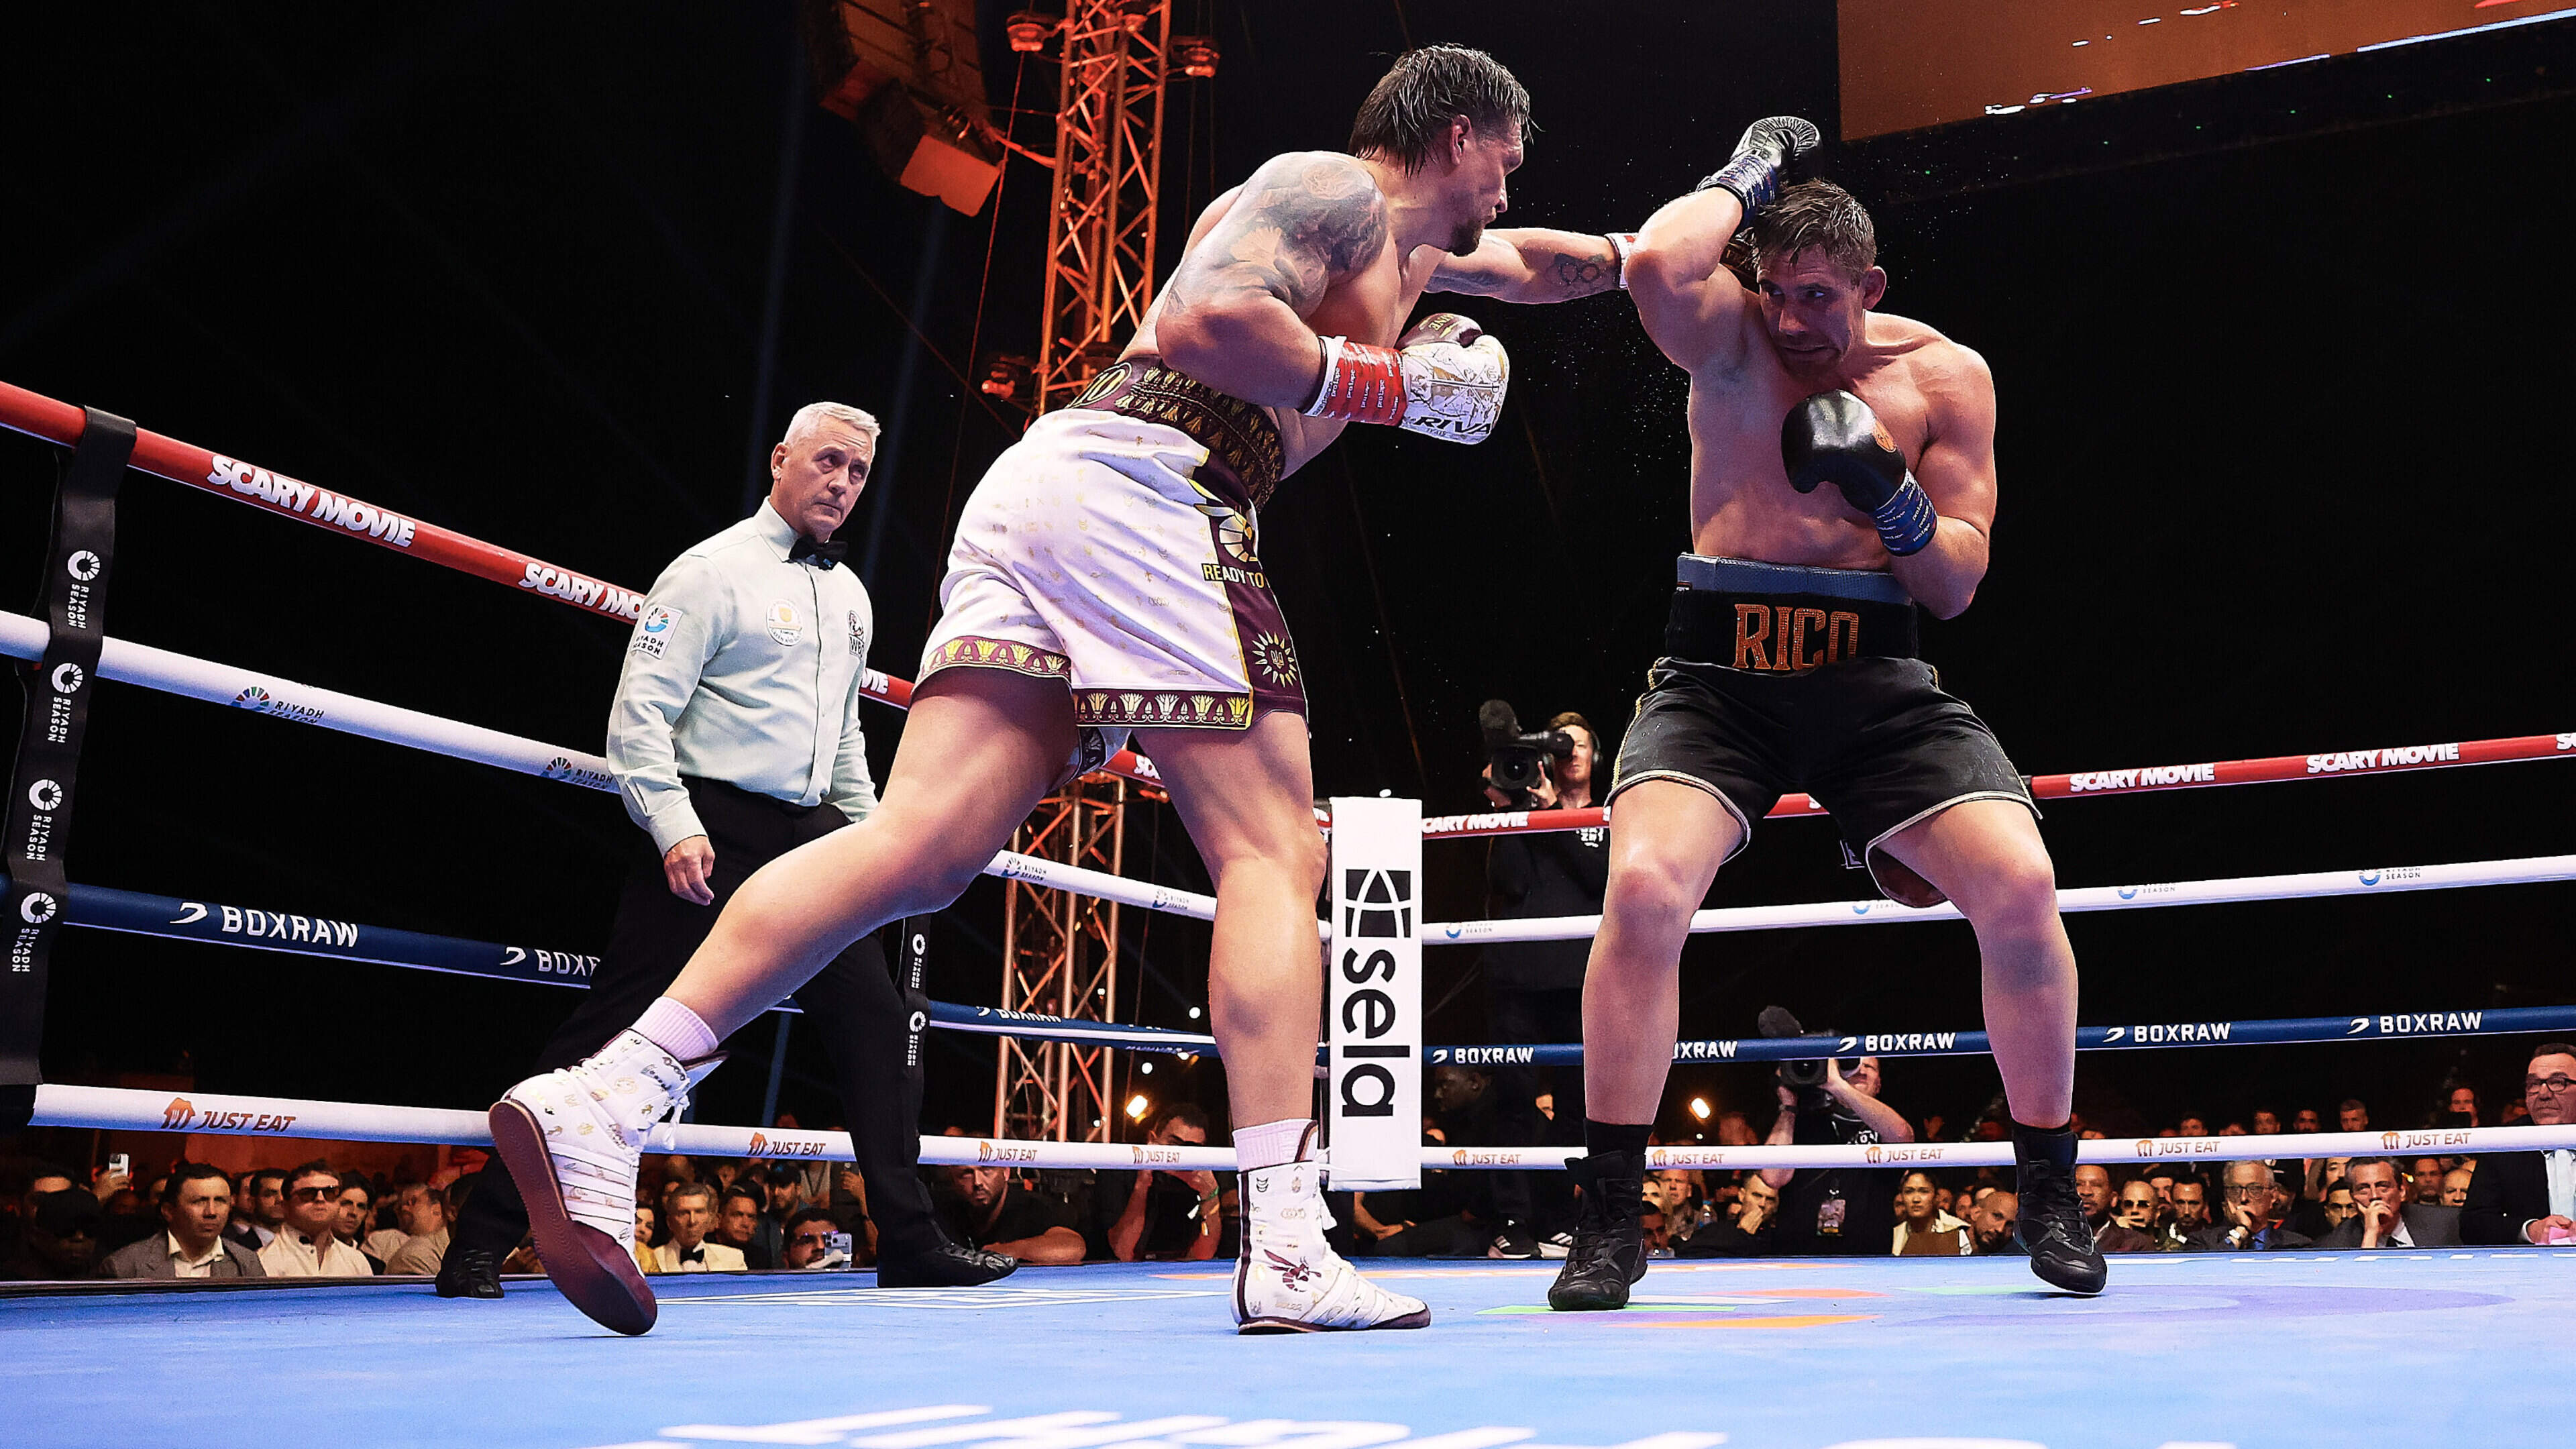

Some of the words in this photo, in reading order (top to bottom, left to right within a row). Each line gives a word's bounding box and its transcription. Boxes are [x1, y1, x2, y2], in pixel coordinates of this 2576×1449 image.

[207, 455, 316, 513] SCARY
[311, 492, 415, 547] MOVIE
[519, 563, 603, 607] SCARY
[1201, 564, 1246, 585] READY
[1246, 572, 1264, 588] TO
[68, 584, 80, 628] SEASON
[78, 586, 90, 629] RIYADH
[1732, 604, 1859, 671] RICO
[861, 667, 889, 694] VIE
[48, 696, 62, 741] SEASON
[58, 698, 71, 743] RIYADH
[275, 701, 325, 718] RIYADH
[2306, 749, 2381, 774] SCARY
[2381, 743, 2459, 766] MOVIE
[576, 769, 613, 784] RIYADH
[2070, 767, 2141, 792] SCARY
[2141, 763, 2214, 787] MOVIE
[1422, 816, 1469, 834] CARY
[1467, 812, 1529, 830] MOVIE
[26, 814, 42, 860] SEASON
[36, 816, 52, 861] RIYADH
[221, 905, 358, 948] BOXRAW
[12, 928, 29, 972] SEASON
[22, 929, 39, 972] RIYADH
[534, 949, 600, 976] BOX
[1342, 947, 1410, 1117] sela
[2134, 1022, 2231, 1042] BOXRAW
[2379, 1011, 2482, 1033] BOXRAW
[1672, 1040, 1738, 1059] XRAW
[1865, 1033, 1955, 1052] BOXRAW
[1454, 1046, 1534, 1064] BOXRAW
[195, 1112, 254, 1130] JUST
[254, 1115, 296, 1132] EAT
[767, 1142, 802, 1156] JUST
[801, 1142, 826, 1157] EAT
[2159, 1141, 2192, 1155] JUST
[2194, 1140, 2220, 1153] EAT
[2406, 1133, 2440, 1148] JUST
[2444, 1132, 2471, 1146] EAT
[993, 1148, 1018, 1161] JUST
[1019, 1148, 1037, 1161] EAT
[1146, 1150, 1163, 1164] JUST
[1164, 1150, 1180, 1164] EAT
[1471, 1153, 1498, 1165] JUST
[1501, 1153, 1521, 1165] EAT
[1672, 1154, 1700, 1165] JUST
[1702, 1152, 1724, 1164] EAT
[1887, 1149, 1916, 1162] JUST
[1919, 1148, 1945, 1161] EAT
